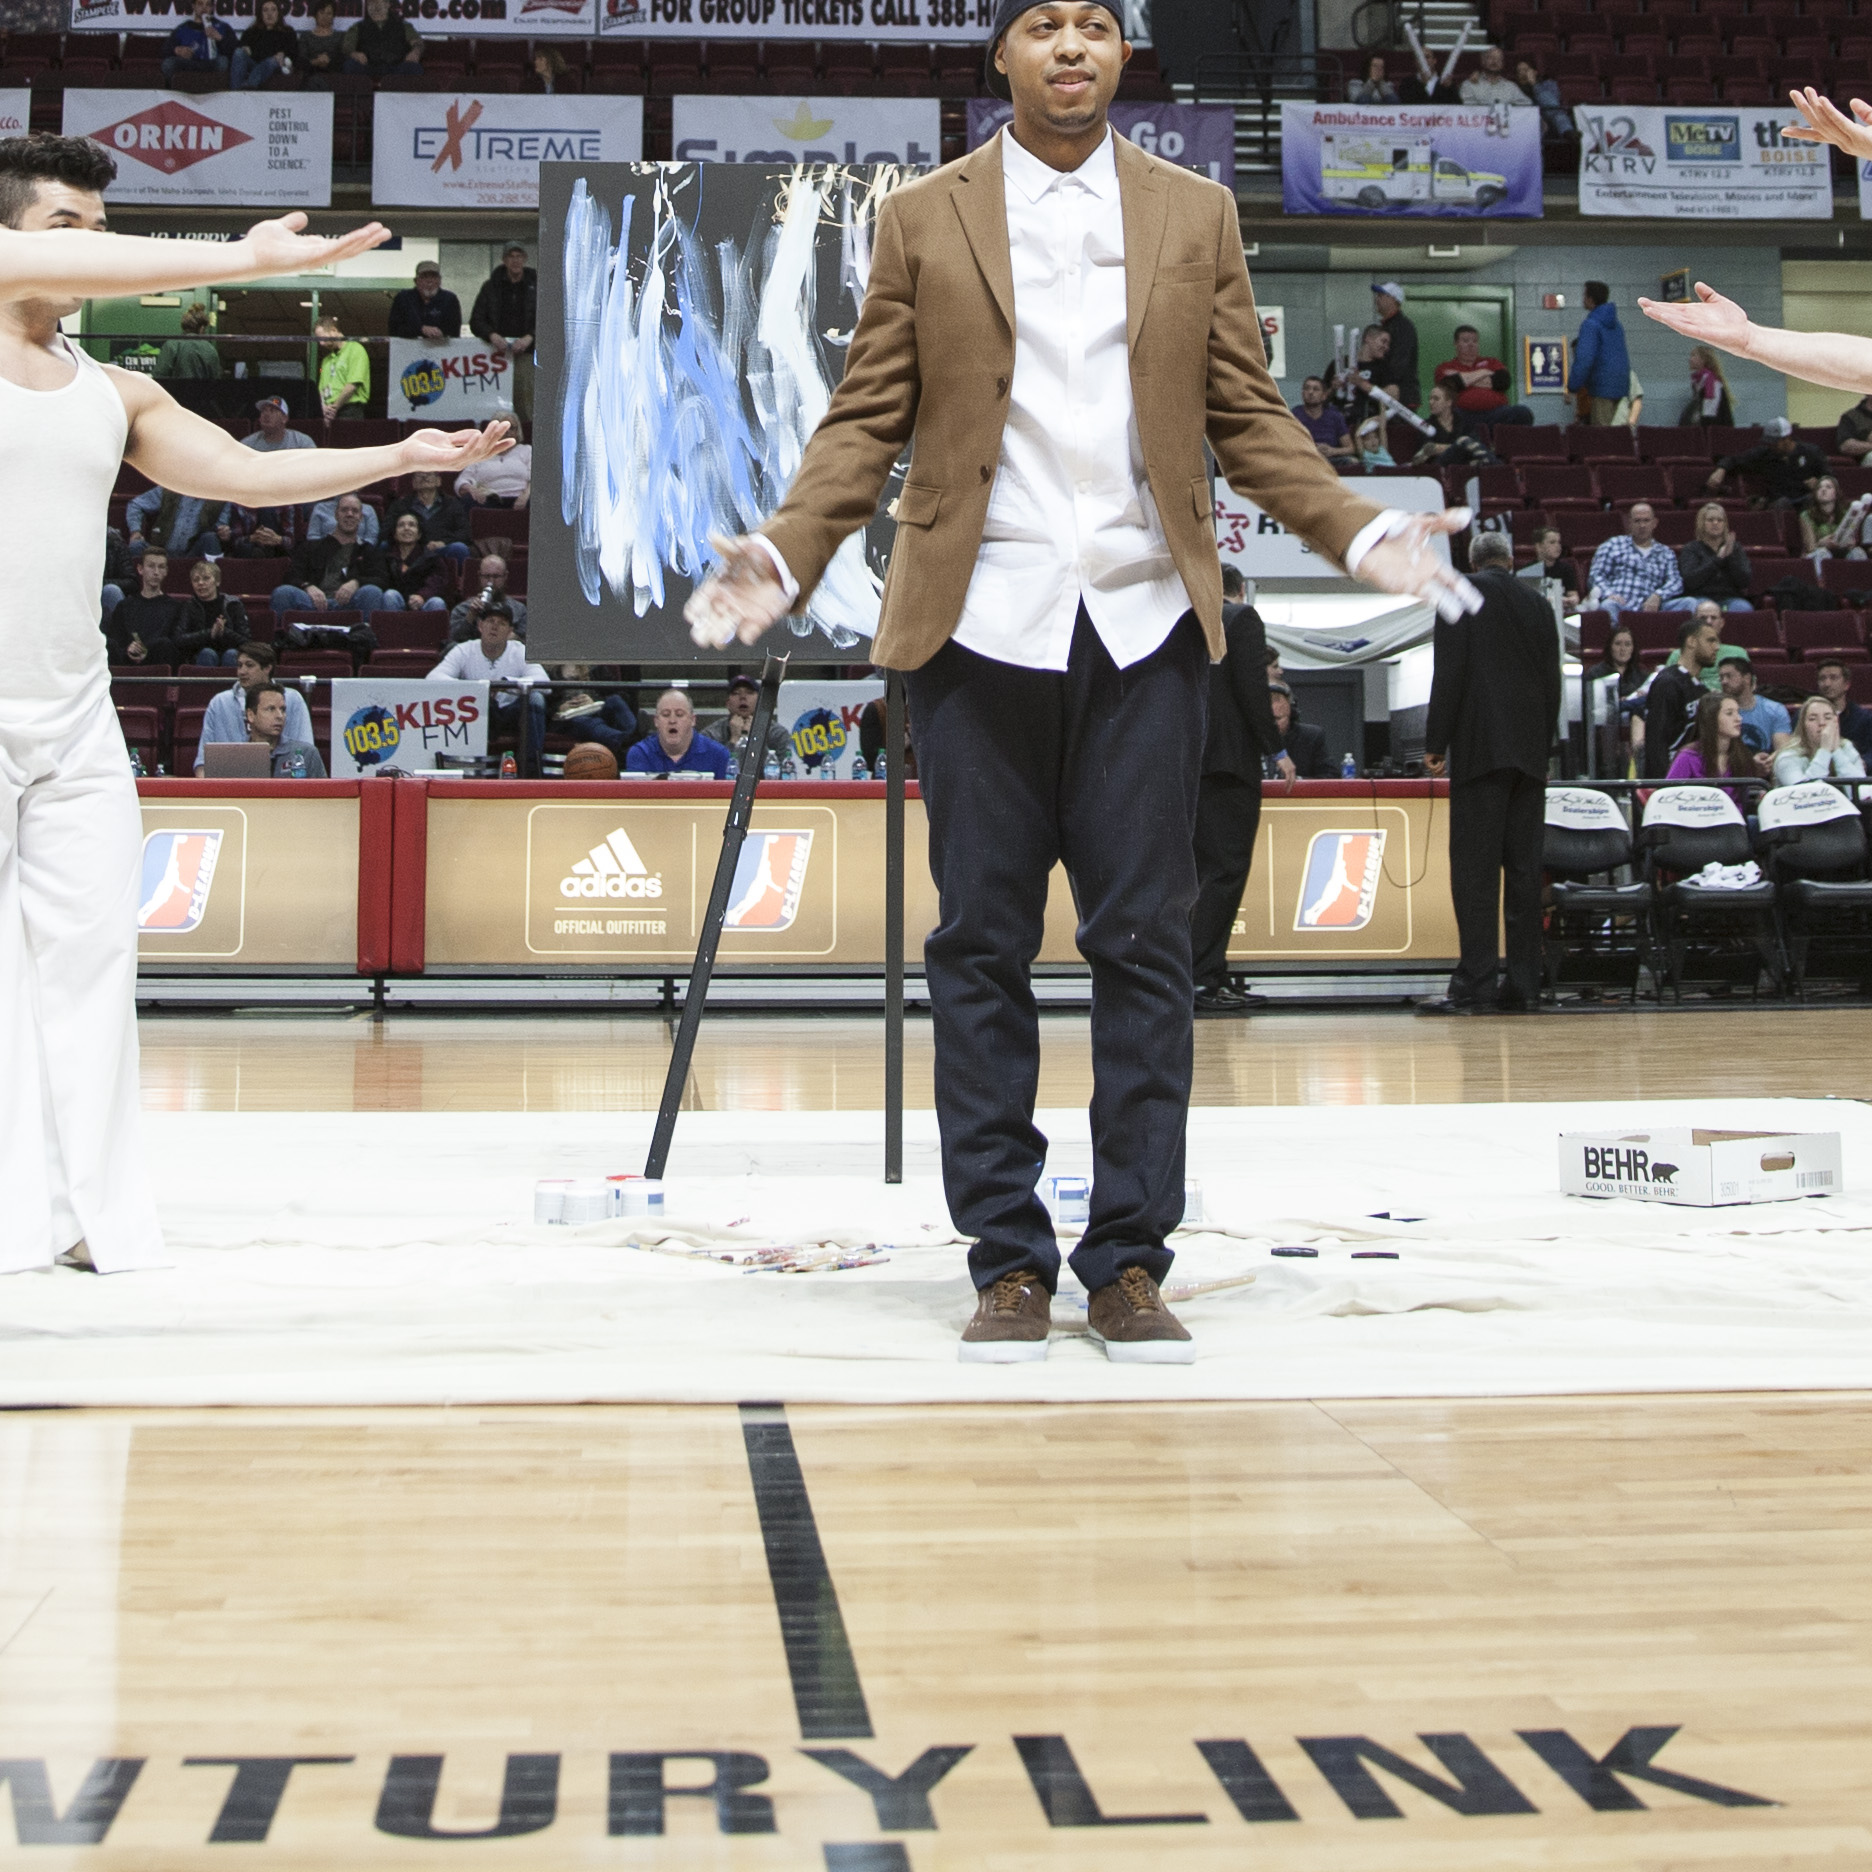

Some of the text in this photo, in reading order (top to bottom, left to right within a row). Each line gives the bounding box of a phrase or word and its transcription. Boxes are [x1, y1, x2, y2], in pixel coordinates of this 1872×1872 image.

[268, 108, 292, 120] PEST
[1312, 110, 1454, 128] Ambulance Service
[113, 122, 224, 151] ORKIN
[268, 121, 310, 133] CONTROL
[1589, 115, 1639, 156] 12
[268, 133, 299, 145] DOWN
[1130, 121, 1185, 157] Go
[268, 146, 290, 158] TO A
[1760, 150, 1818, 163] BOISE
[1585, 157, 1657, 175] KTRV
[1595, 188, 1668, 200] Entertainment
[1724, 190, 1762, 202] Movies
[1764, 189, 1784, 201] and
[400, 351, 508, 399] 103.5 KISS
[461, 372, 501, 395] FM
[343, 695, 480, 756] 103.5 KISS
[421, 722, 469, 751] FM
[790, 719, 847, 759] 103.5
[559, 871, 663, 899] adidas
[554, 920, 667, 935] OFFICIAL OUTFITTER
[1583, 1145, 1650, 1183] BEHR
[1584, 1181, 1616, 1194] GOOD.
[1618, 1183, 1652, 1196] BETTER.
